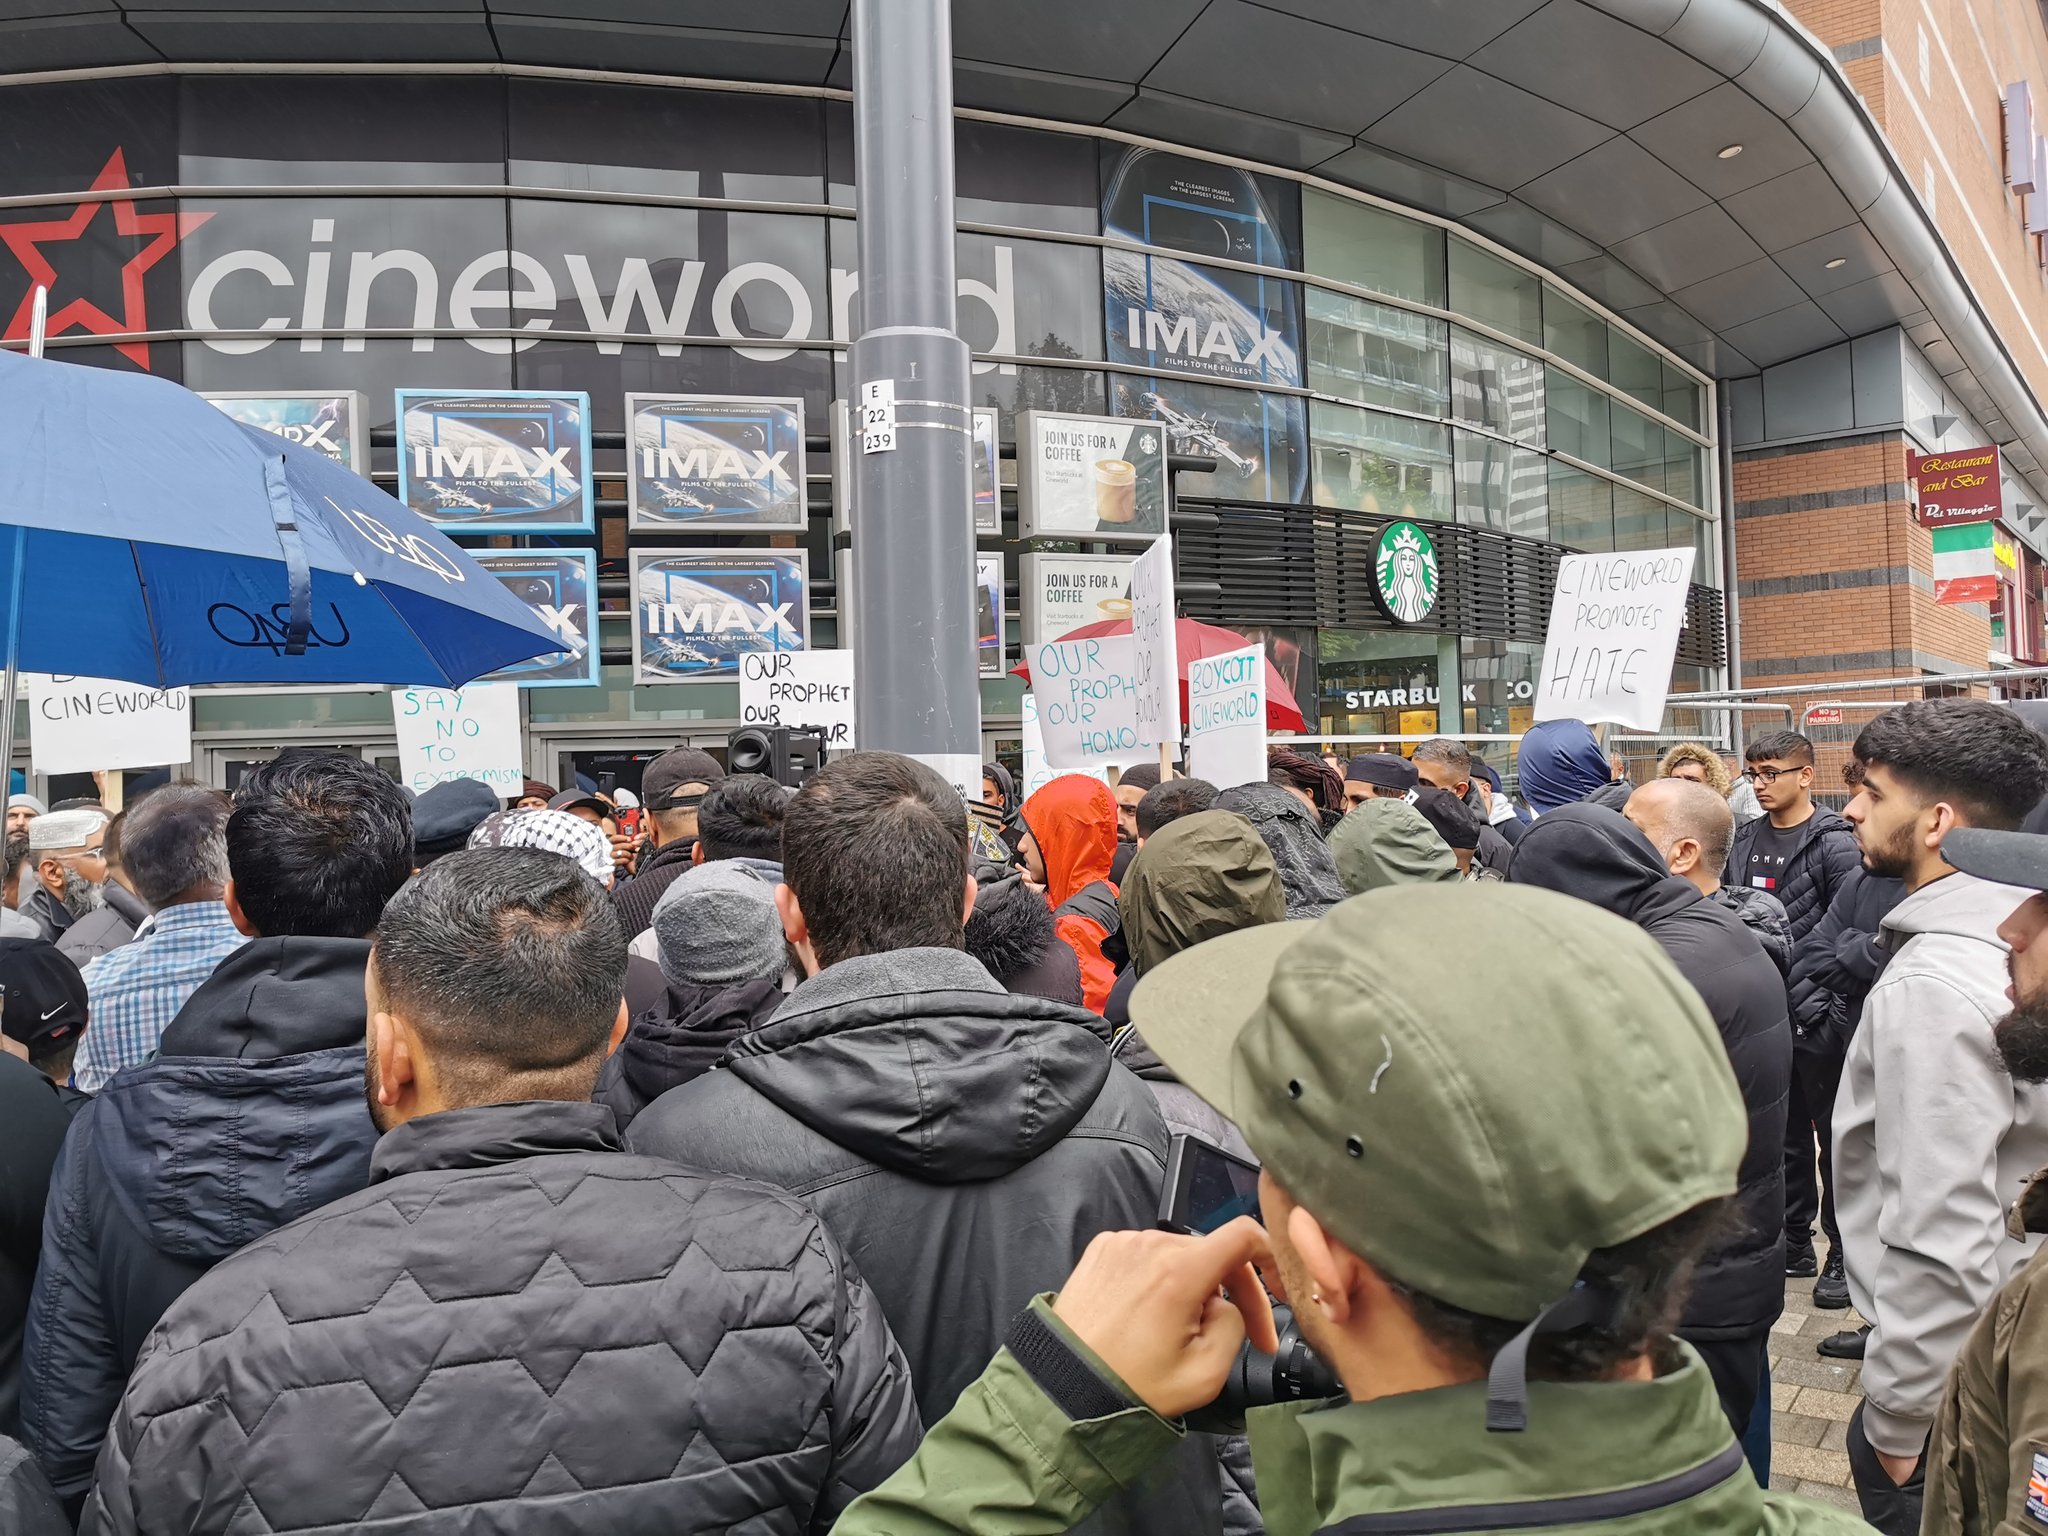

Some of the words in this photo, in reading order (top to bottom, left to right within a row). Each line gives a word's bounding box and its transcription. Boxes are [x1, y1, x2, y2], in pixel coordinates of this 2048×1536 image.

[1185, 181, 1211, 192] CLEAREST
[1211, 187, 1230, 196] IMAGES
[1190, 188, 1212, 199] LARGEST
[1212, 193, 1235, 203] SCREENS
[187, 218, 1017, 376] cineword
[1127, 307, 1285, 370] IMAX
[1165, 357, 1189, 368] FILMS
[1191, 360, 1202, 369] TO
[1203, 362, 1218, 371] THE
[1220, 364, 1253, 376] FULLEST
[871, 385, 879, 399] E
[868, 408, 886, 424] 22
[865, 434, 891, 450] 239
[1044, 431, 1068, 447] JOIN
[1071, 433, 1085, 448] US
[1087, 435, 1107, 450] FOR
[1109, 437, 1117, 450] A
[414, 446, 575, 478] IMAX
[643, 448, 792, 481] IMAX
[1045, 446, 1082, 462] COFFEE
[1921, 454, 1994, 474] Restaurant
[1922, 477, 1948, 493] and
[1950, 473, 1988, 489] Bar
[1924, 503, 1944, 518] Del
[1946, 504, 1998, 516] Villaggio
[1046, 573, 1070, 588] JOIN
[1073, 574, 1086, 588] US
[1089, 575, 1108, 588] FOR
[1111, 576, 1118, 589] A
[1559, 557, 1683, 599] CINEWORLD
[1046, 589, 1084, 603] COFFEE
[647, 602, 798, 634] IMAX
[1574, 603, 1663, 632] PROMOTES
[745, 653, 796, 681] OUR
[1039, 639, 1105, 678] OUR
[1192, 655, 1256, 695] BOYCOTT
[1550, 646, 1648, 701] HATE
[770, 682, 851, 703] PROPHET
[1070, 674, 1136, 702] PROPH
[42, 690, 186, 720] CINEWORLD
[404, 689, 465, 716] SAY
[744, 704, 781, 723] OUR
[1048, 702, 1096, 725] OUR
[1193, 690, 1258, 730] CINEWORLD
[1818, 708, 1830, 716] NO
[436, 718, 480, 740] NO
[1080, 727, 1150, 756] HONO
[420, 744, 456, 763] TO
